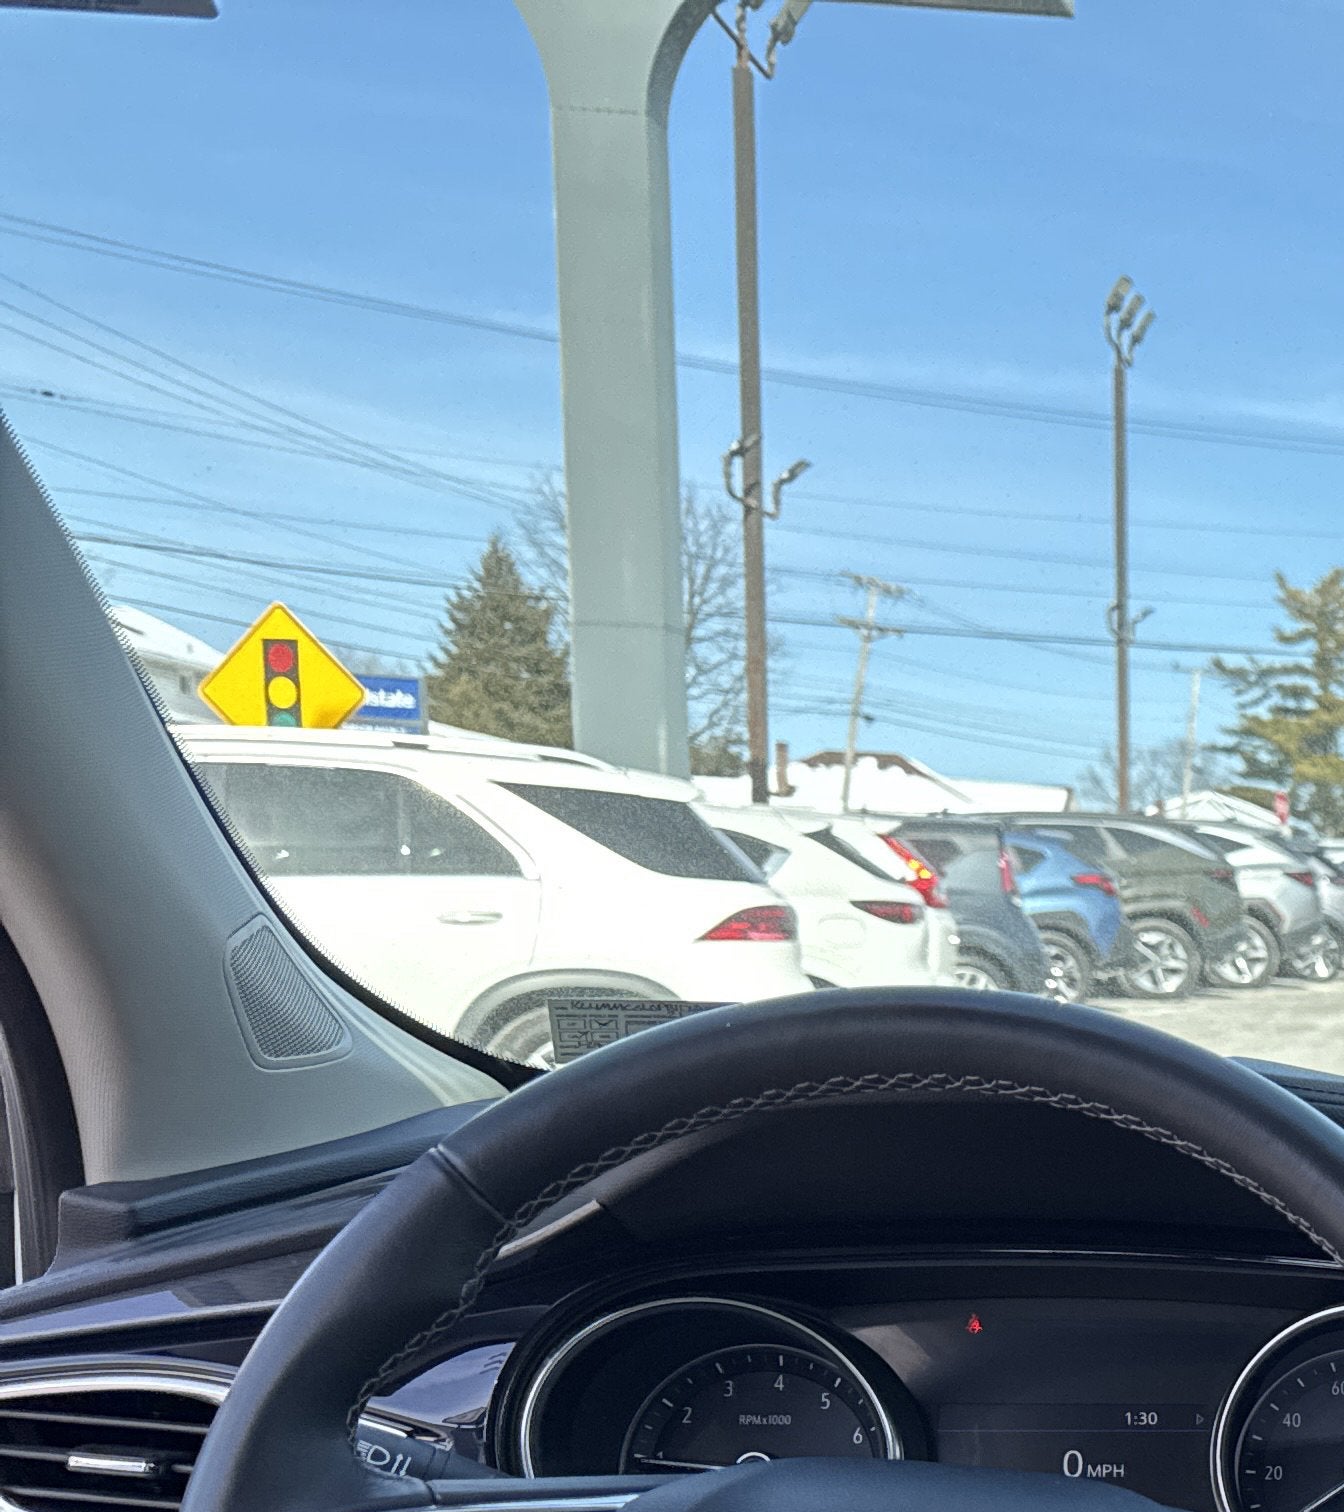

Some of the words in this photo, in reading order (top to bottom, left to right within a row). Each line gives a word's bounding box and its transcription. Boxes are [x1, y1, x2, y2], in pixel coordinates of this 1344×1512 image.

[723, 1379, 734, 1397] 3
[773, 1374, 784, 1391] 4
[820, 1392, 831, 1410] 5
[681, 1406, 692, 1424] 2
[1124, 1411, 1158, 1426] 1:30
[1282, 1412, 1301, 1428] 40
[852, 1426, 863, 1444] 6
[1063, 1449, 1083, 1478] 0
[1086, 1463, 1125, 1478] MPH
[1264, 1465, 1283, 1481] 20
